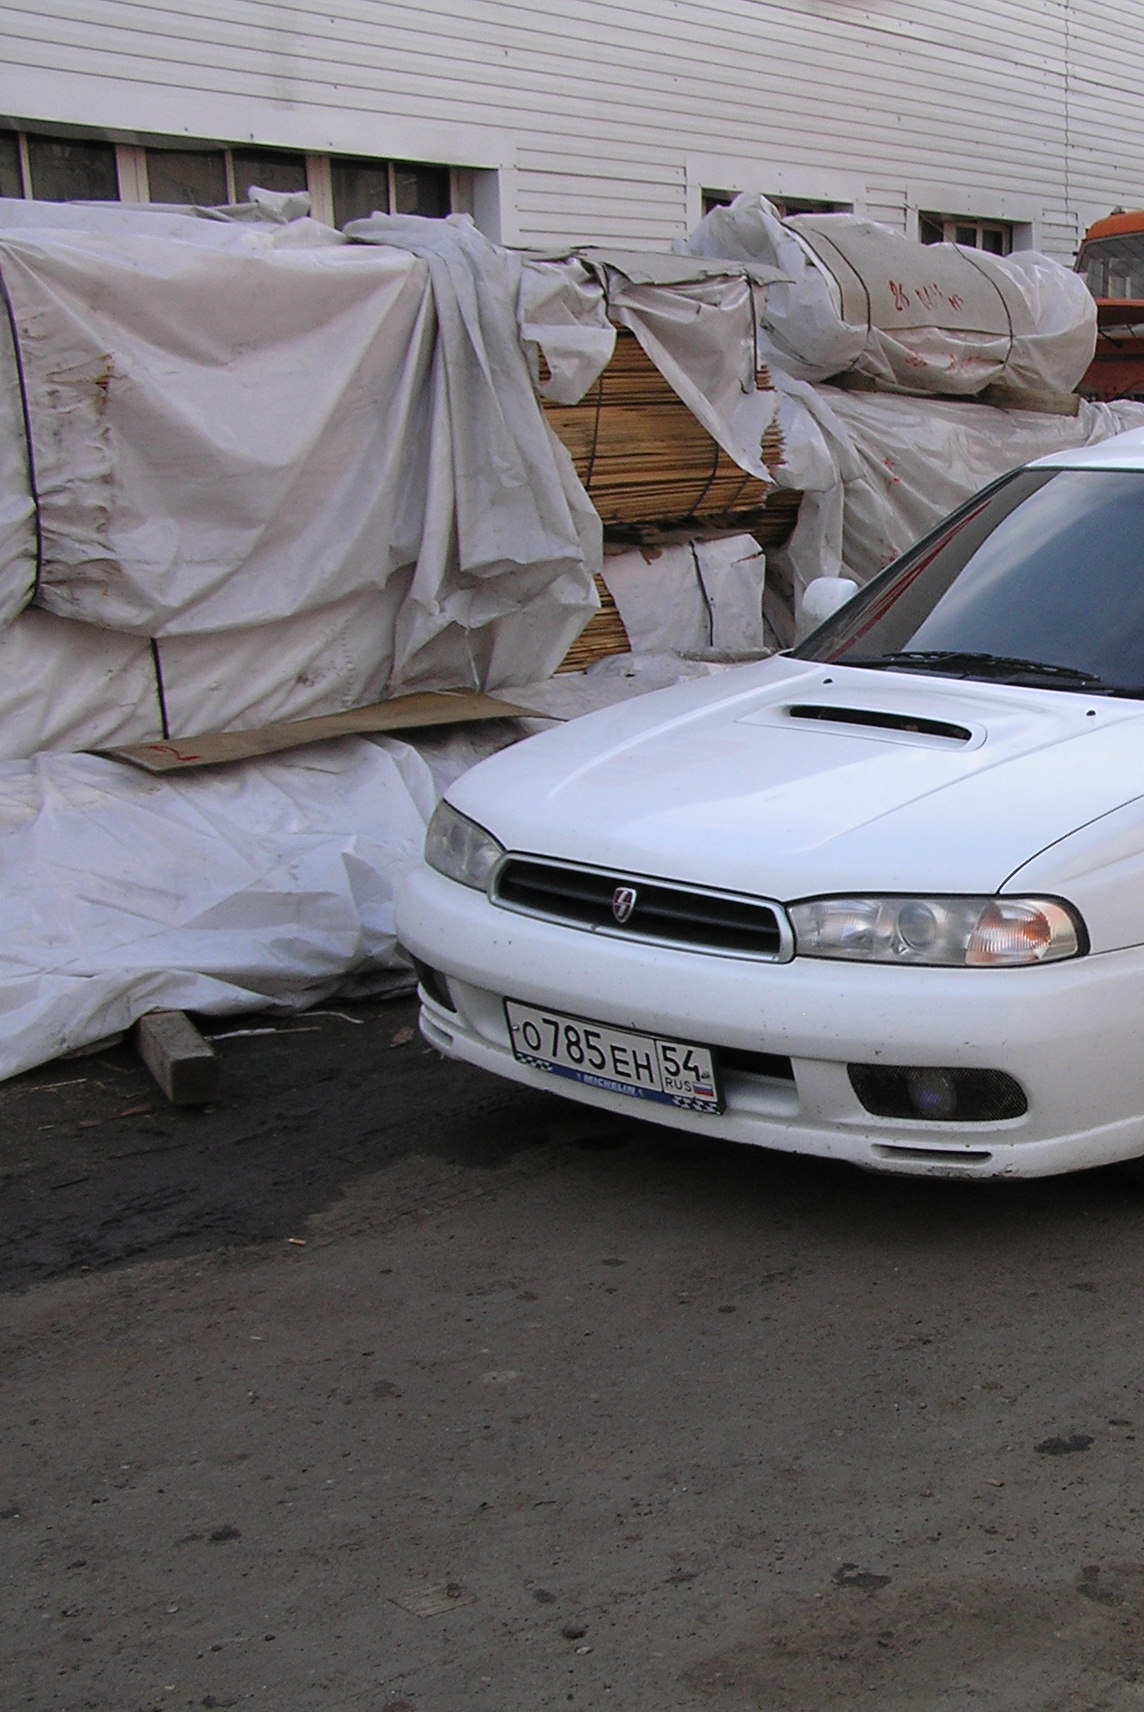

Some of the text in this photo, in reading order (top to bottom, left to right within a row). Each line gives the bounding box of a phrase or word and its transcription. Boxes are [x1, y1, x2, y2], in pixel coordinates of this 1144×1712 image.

[661, 1045, 701, 1082] 54
[583, 1073, 637, 1097] MICHELIN
[665, 1077, 692, 1093] RUS
